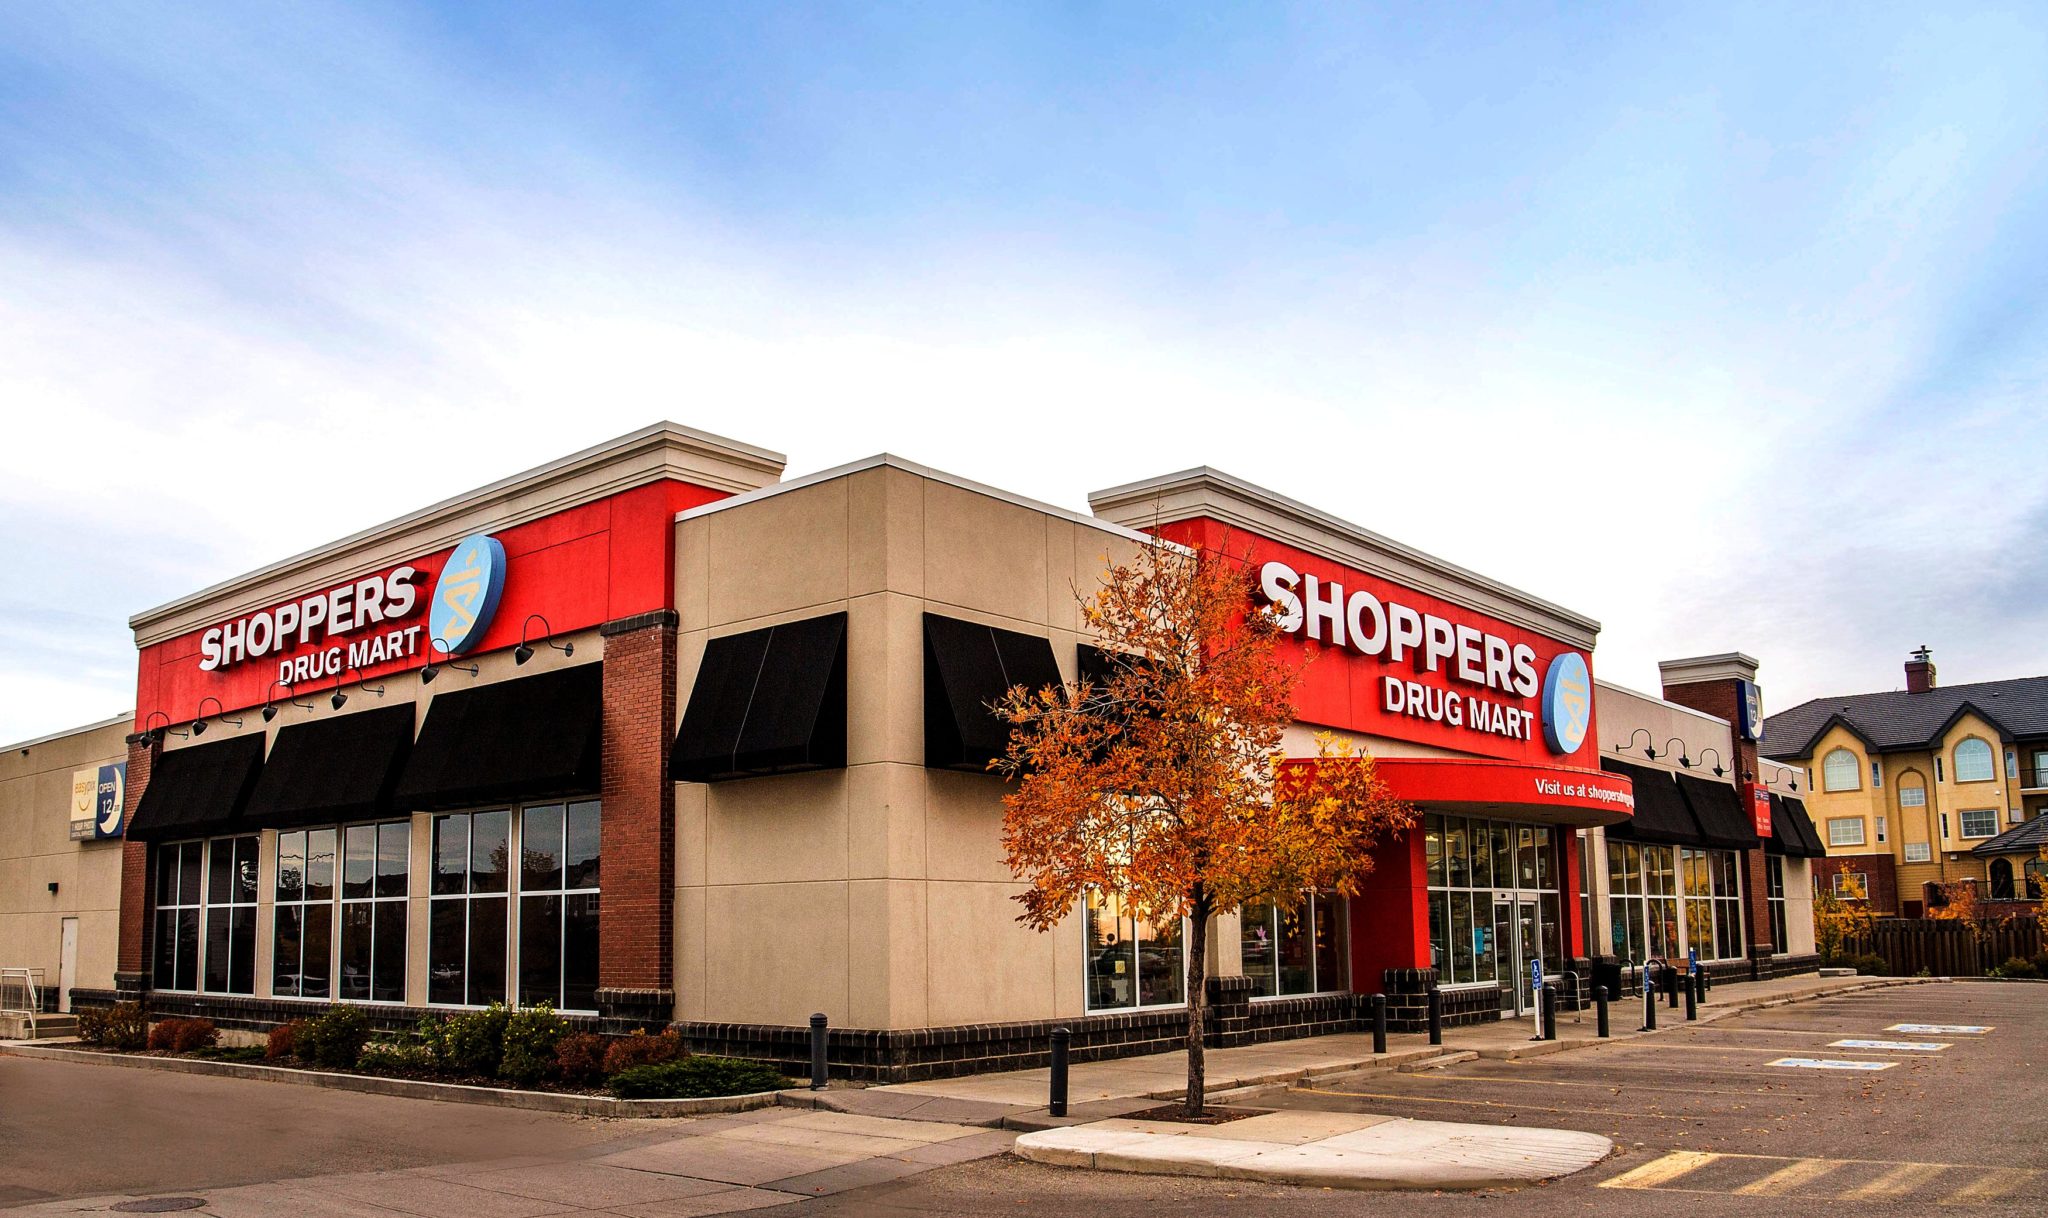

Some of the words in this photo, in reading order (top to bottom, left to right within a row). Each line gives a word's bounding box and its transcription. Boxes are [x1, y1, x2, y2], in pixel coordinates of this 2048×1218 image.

[198, 566, 416, 671] SHOPPERS
[1260, 561, 1538, 698] SHOPPERS
[280, 647, 341, 686] DRUG
[347, 625, 421, 669] MART
[1385, 676, 1463, 726] DRUG
[1469, 697, 1534, 740] MART
[99, 781, 116, 794] OPEN
[103, 799, 112, 814] 12
[1535, 778, 1561, 795] Visit
[1563, 785, 1575, 796] us
[1577, 783, 1586, 798] at
